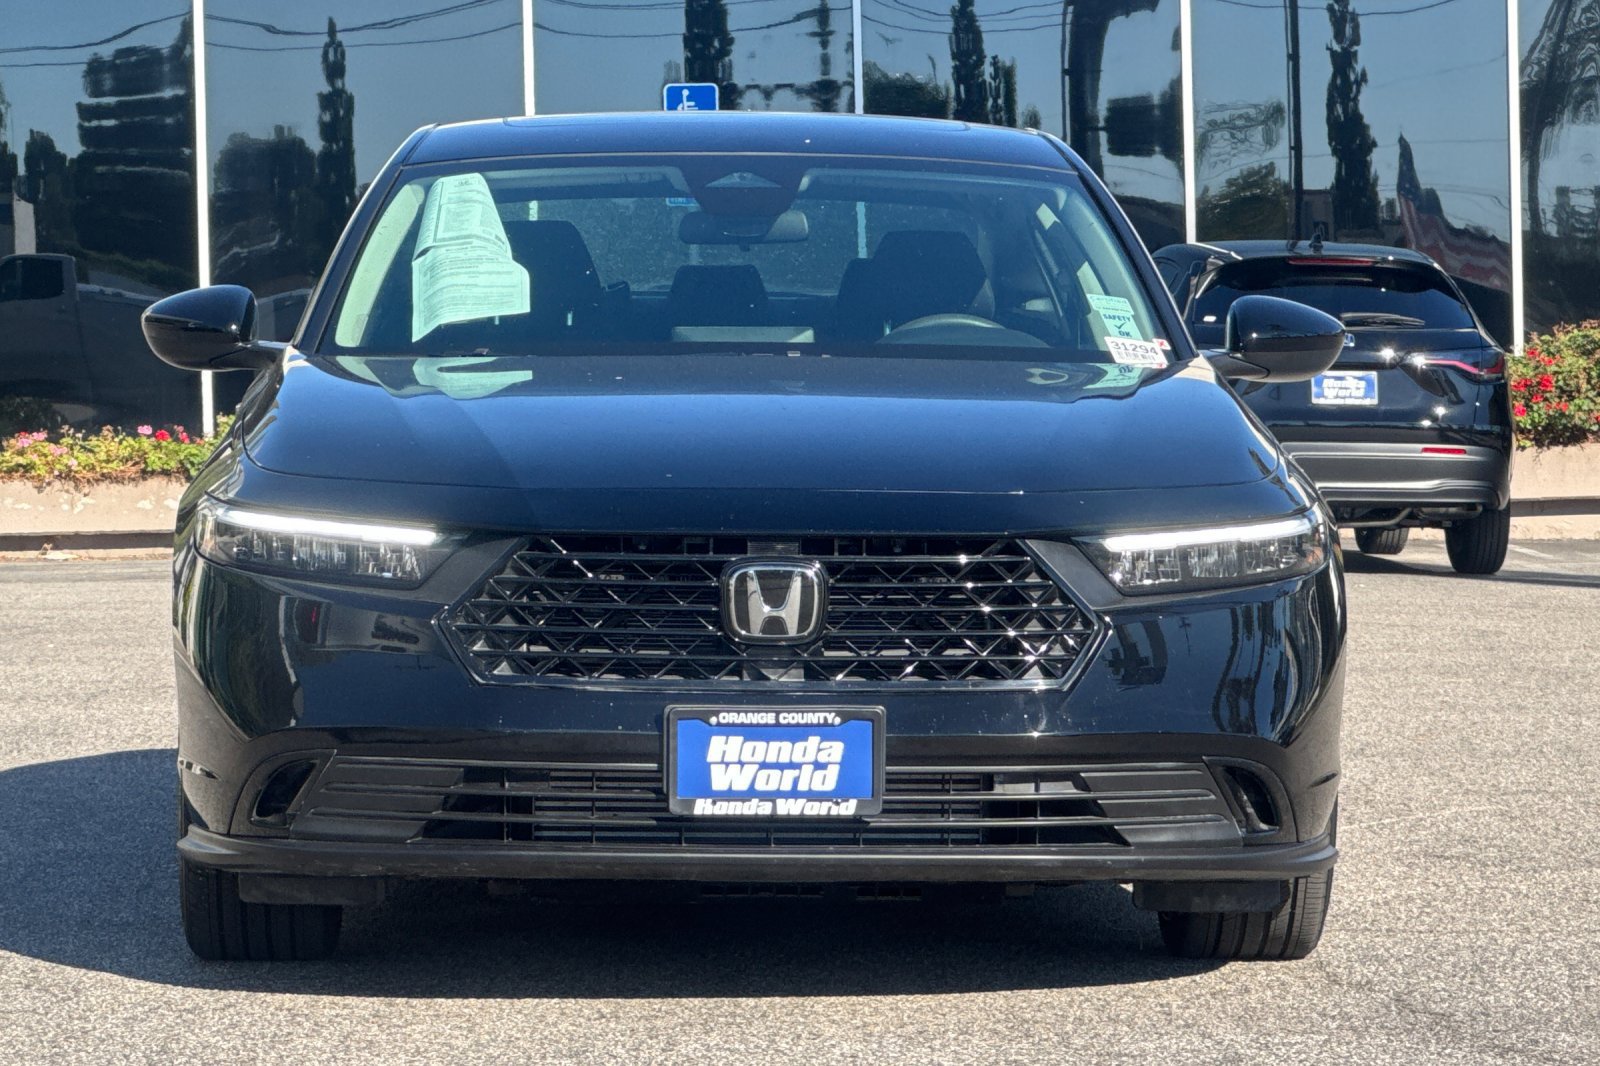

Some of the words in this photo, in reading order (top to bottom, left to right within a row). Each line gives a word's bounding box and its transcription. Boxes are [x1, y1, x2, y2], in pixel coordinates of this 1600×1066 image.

[1102, 313, 1131, 322] SAFETY
[1110, 340, 1158, 355] 31294
[1323, 388, 1365, 398] World
[719, 712, 775, 724] ORANGE
[779, 712, 835, 724] COUNTY
[706, 735, 845, 763] Honda
[710, 764, 841, 792] World
[693, 799, 773, 815] Honda
[775, 799, 857, 815] World
